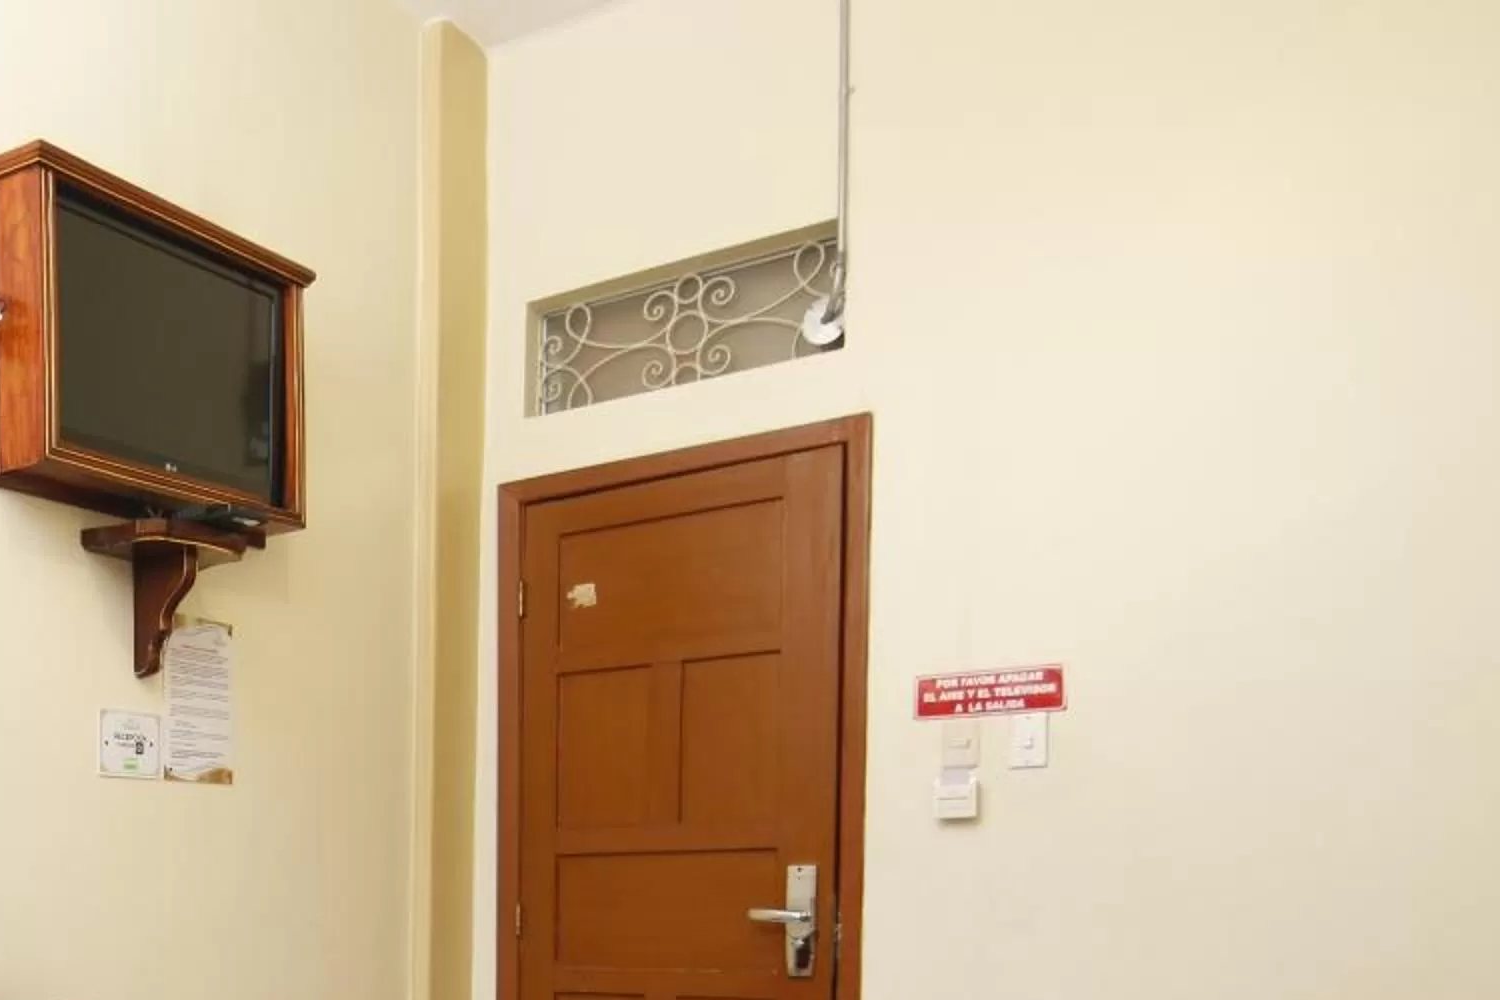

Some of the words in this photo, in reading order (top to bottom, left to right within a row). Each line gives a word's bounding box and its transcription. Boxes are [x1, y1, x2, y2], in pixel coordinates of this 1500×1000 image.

[935, 679, 959, 689] POR
[960, 675, 996, 687] FAVOR
[998, 671, 1044, 684] APAGAR
[923, 692, 937, 703] EL
[966, 688, 975, 699] Y
[977, 687, 990, 699] EL
[994, 682, 1057, 698] TELEVISOR
[954, 703, 964, 713] A
[967, 701, 983, 713] LA
[985, 698, 1025, 710] SALIDA
